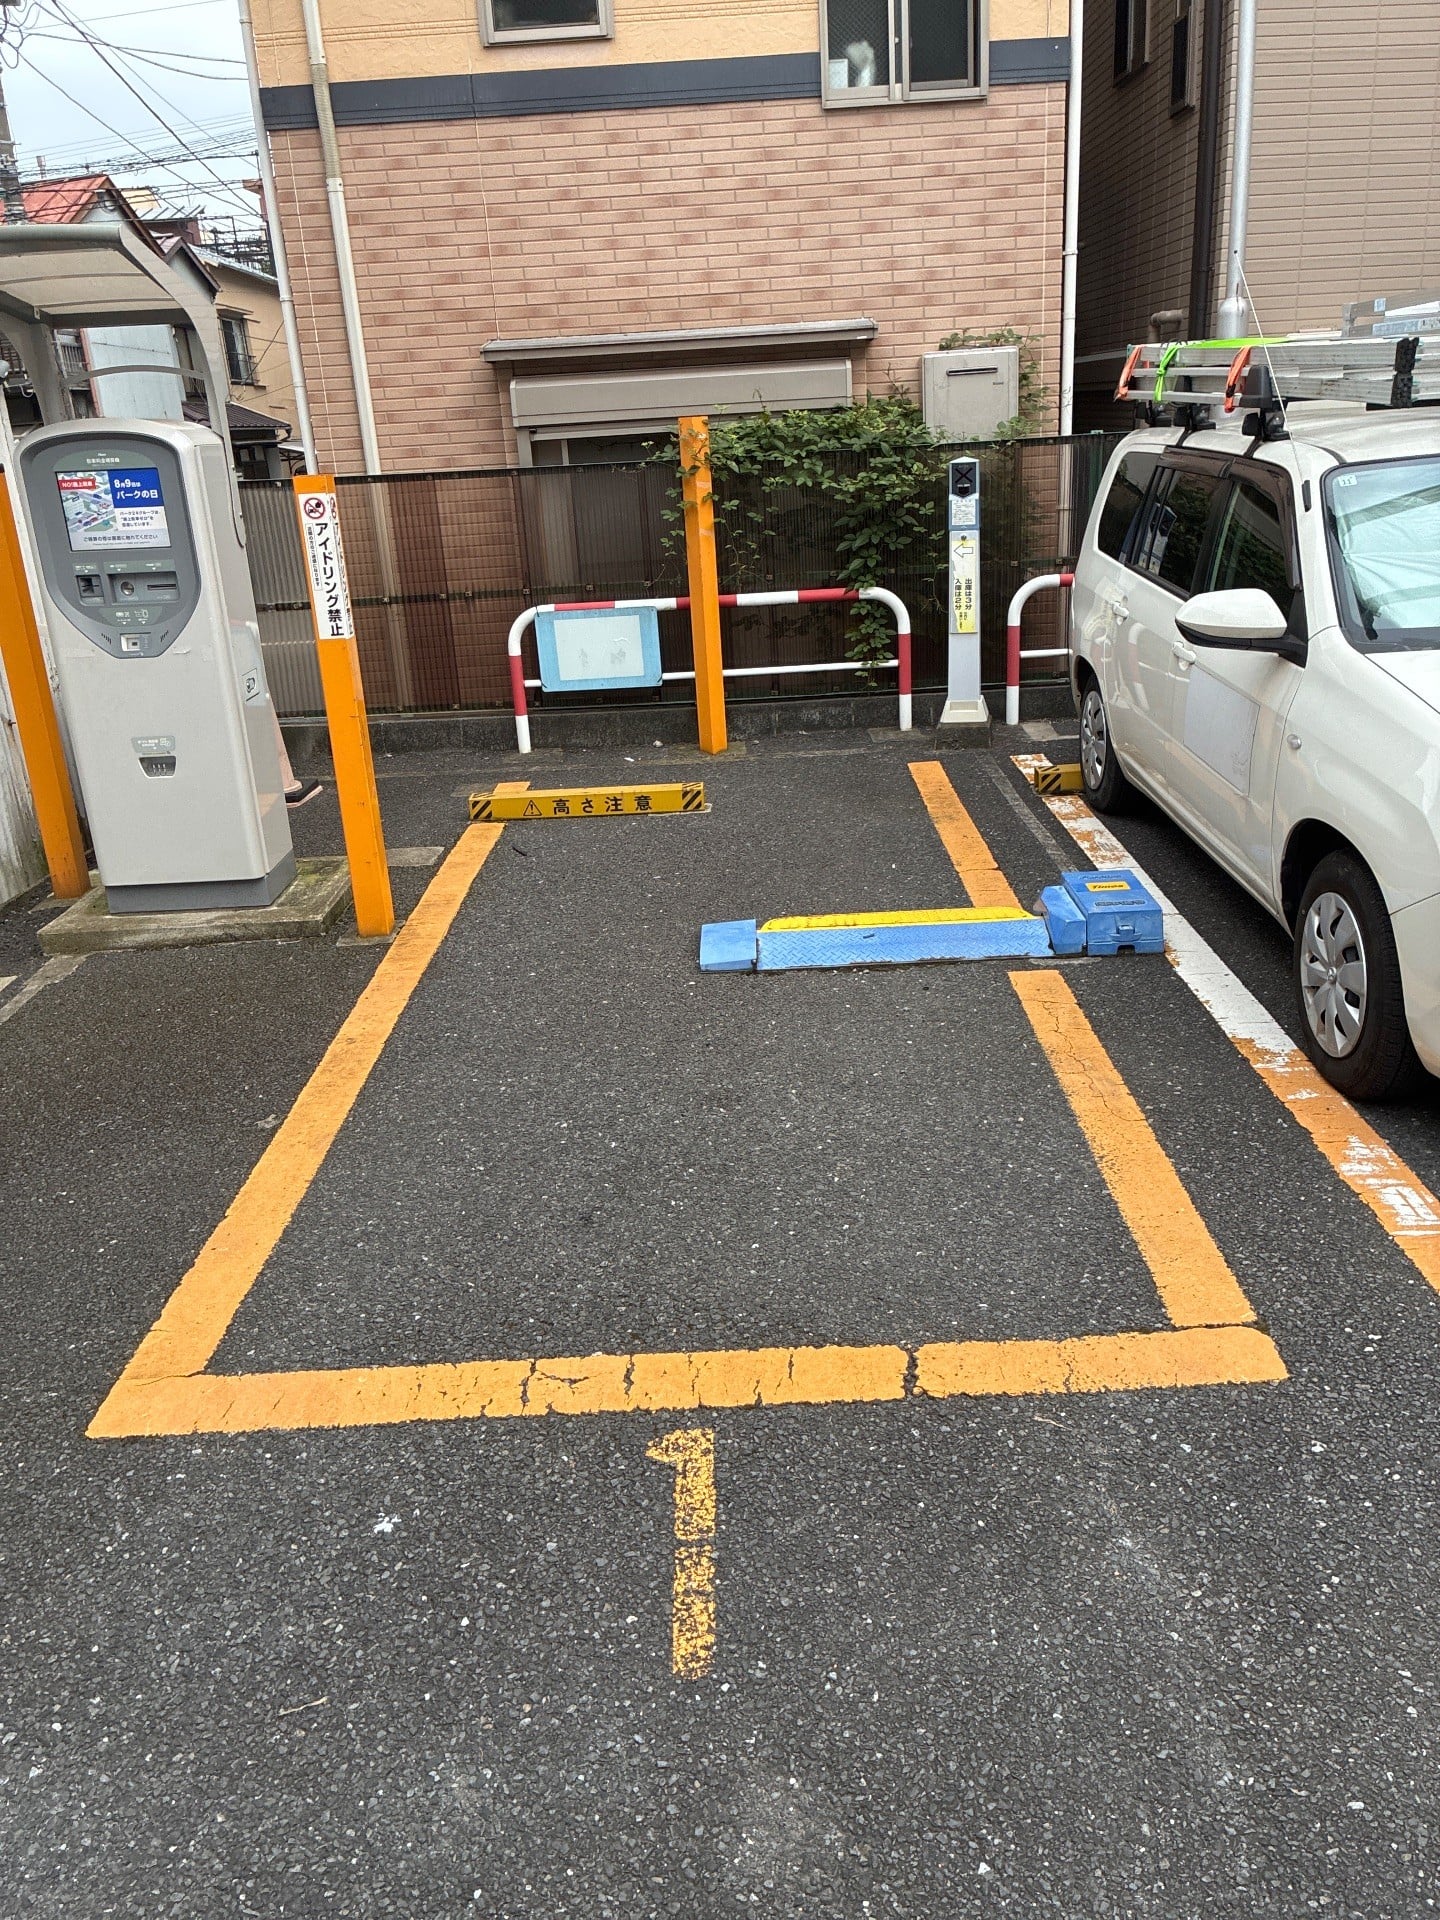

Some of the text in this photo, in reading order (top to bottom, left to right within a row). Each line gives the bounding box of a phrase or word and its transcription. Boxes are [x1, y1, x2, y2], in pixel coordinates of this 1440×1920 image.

[116, 489, 159, 500] パークの日
[315, 522, 345, 637] アイドリング禁止
[552, 794, 653, 815] 高さ注意
